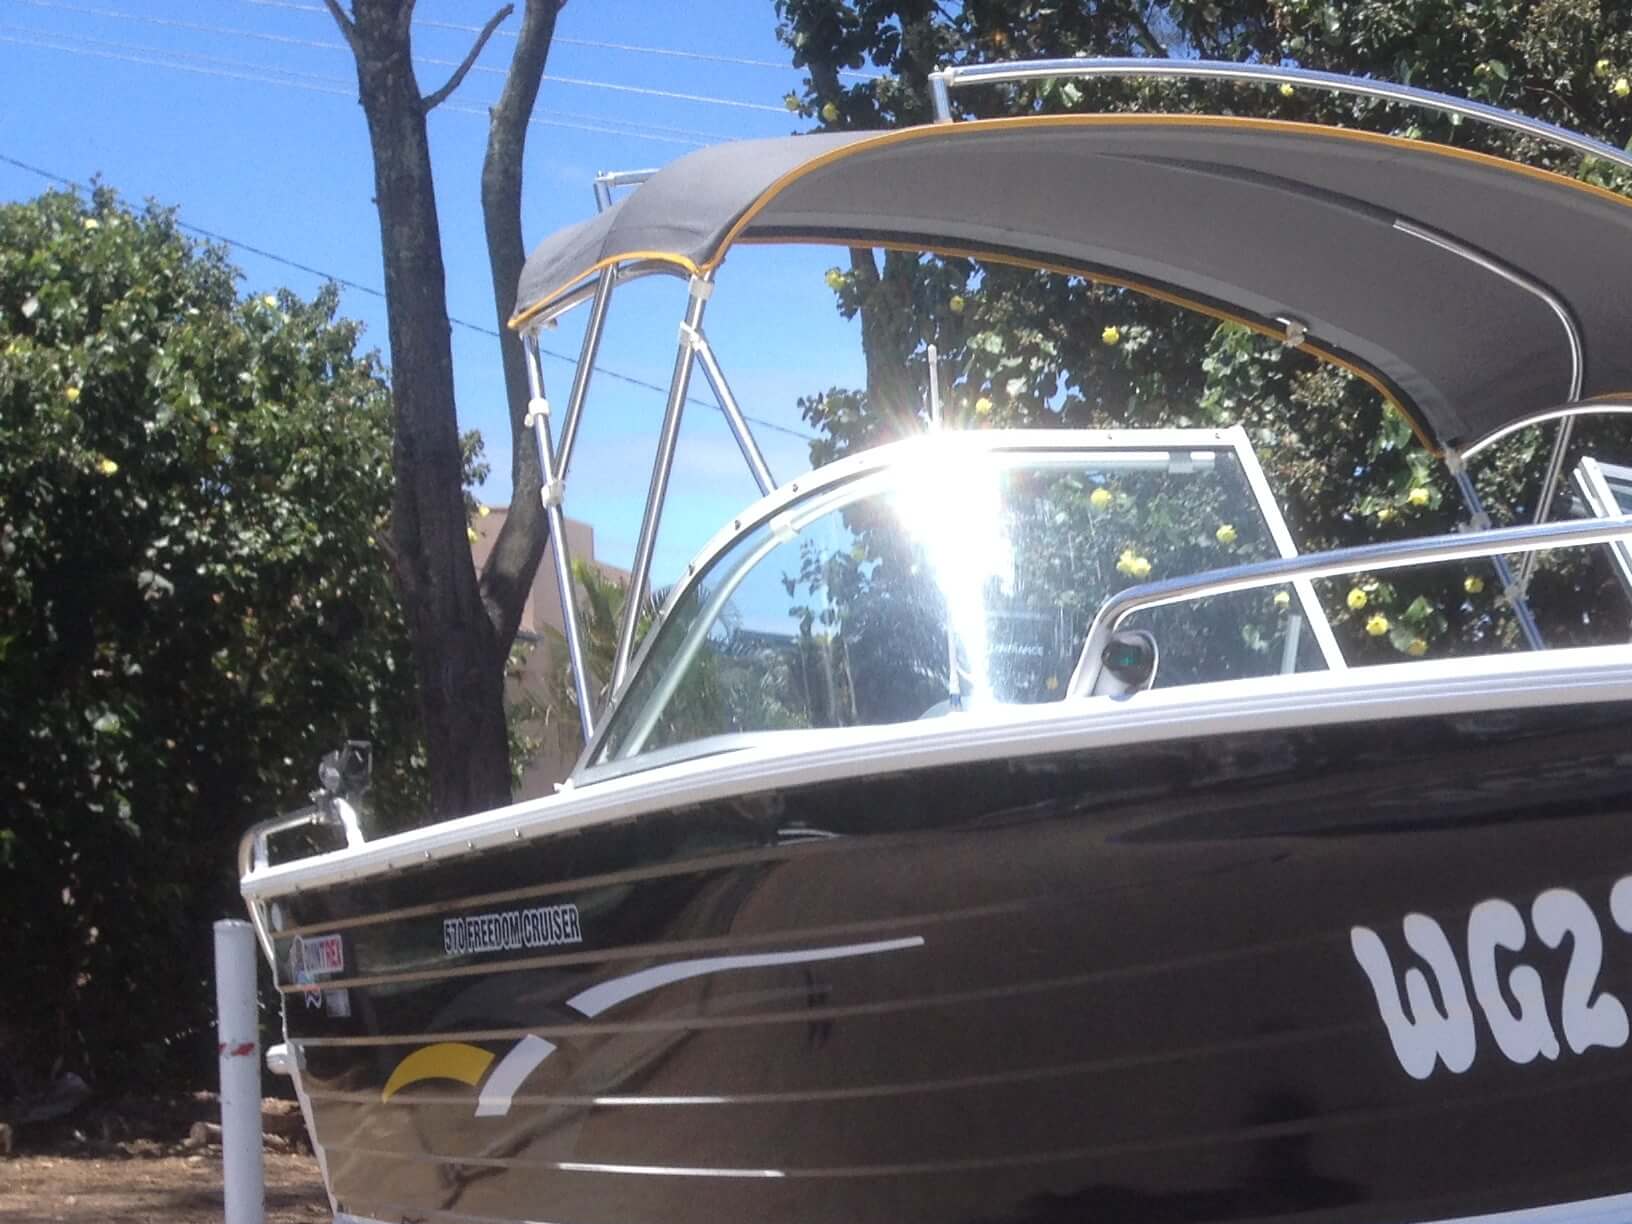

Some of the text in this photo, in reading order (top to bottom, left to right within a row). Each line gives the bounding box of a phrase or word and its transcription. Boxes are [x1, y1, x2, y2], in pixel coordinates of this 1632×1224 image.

[444, 904, 582, 953] 570 FREEDOM CRUISER
